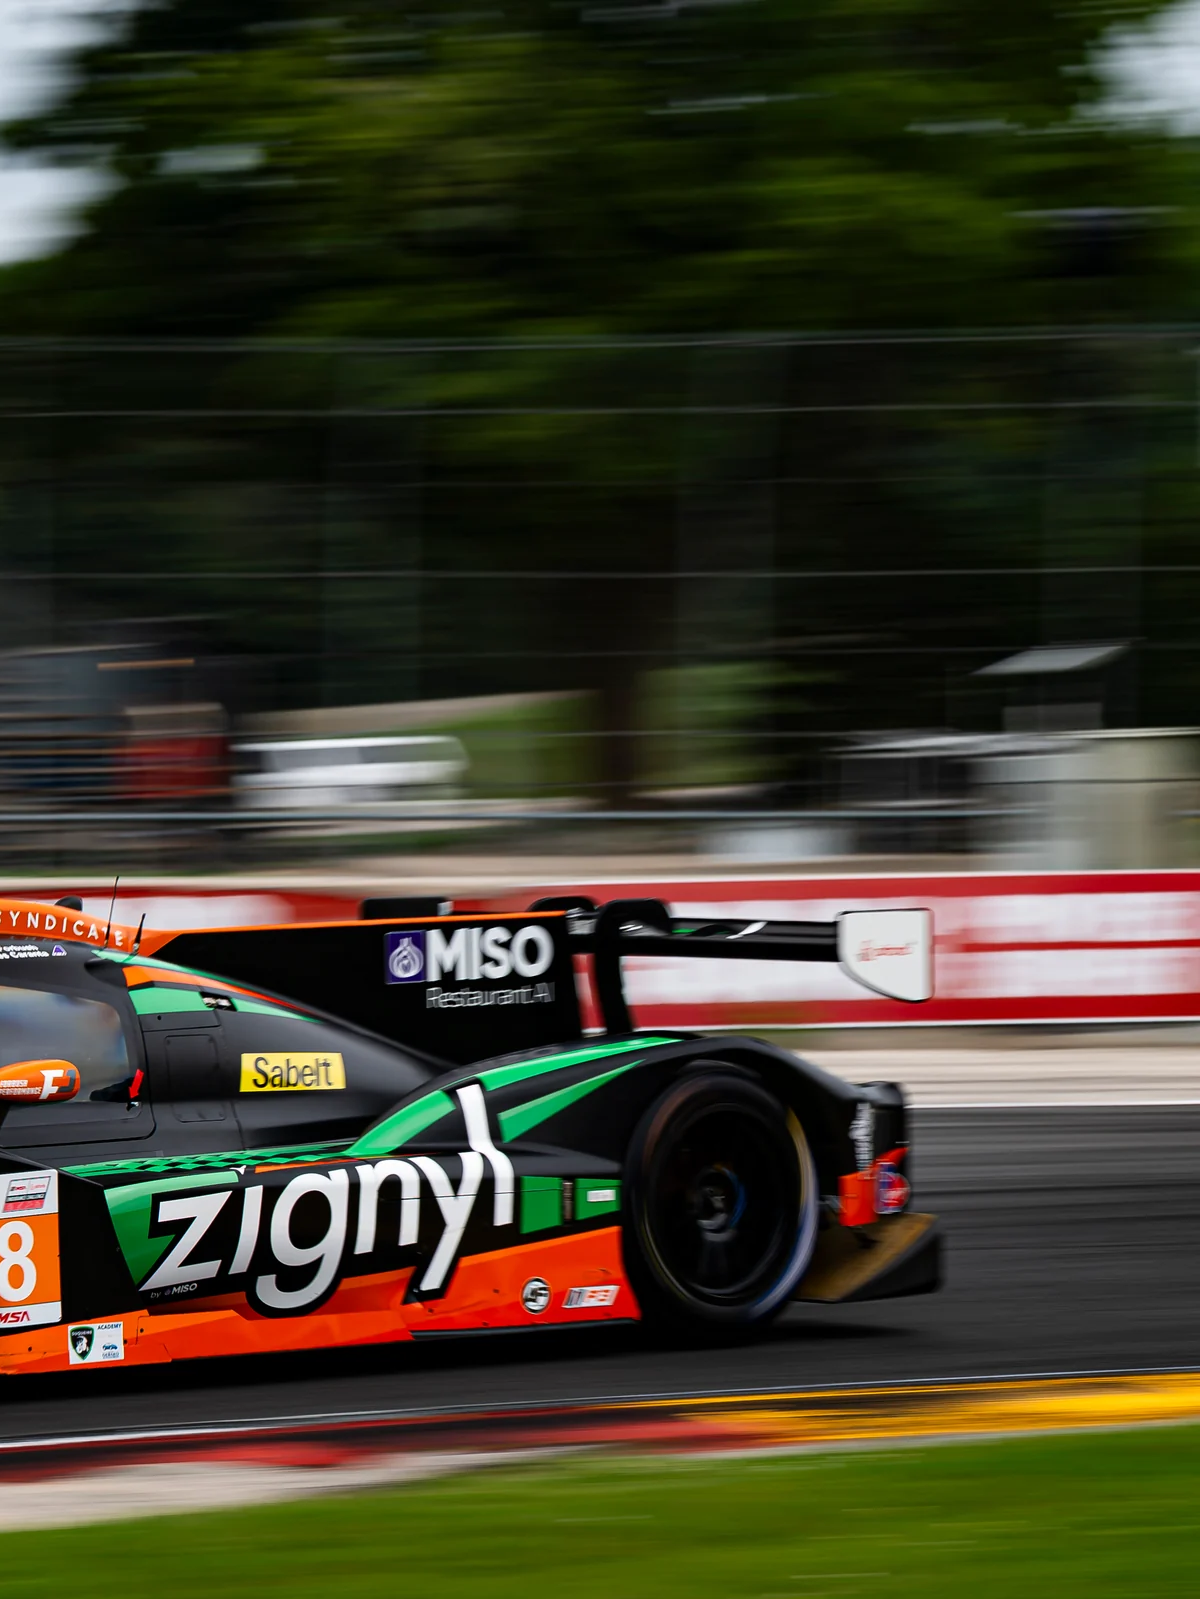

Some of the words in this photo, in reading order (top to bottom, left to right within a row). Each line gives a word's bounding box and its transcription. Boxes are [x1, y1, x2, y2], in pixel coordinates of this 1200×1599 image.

[426, 925, 554, 982] MISO
[252, 1056, 334, 1088] Sabelt
[150, 1291, 161, 1299] by
[171, 1282, 198, 1295] MISO
